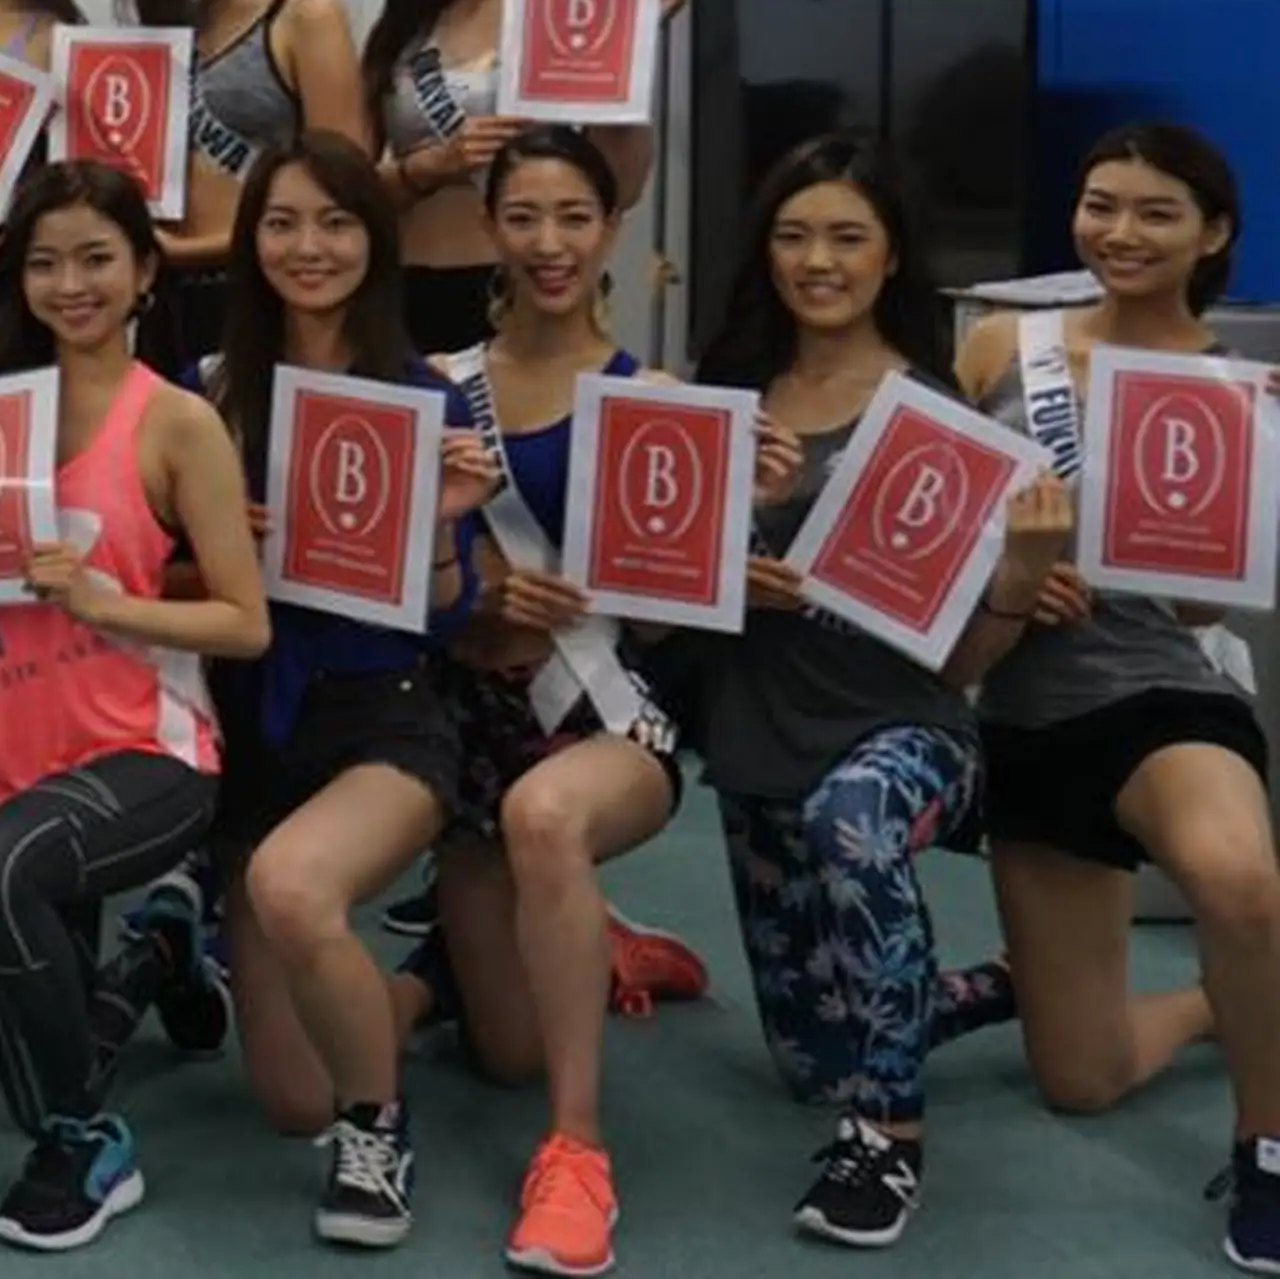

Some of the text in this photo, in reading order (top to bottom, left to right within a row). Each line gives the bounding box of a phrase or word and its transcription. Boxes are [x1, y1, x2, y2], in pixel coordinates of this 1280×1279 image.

[104, 75, 131, 126] B
[336, 440, 366, 503] B
[646, 445, 679, 508] B
[1162, 418, 1198, 482] B
[897, 464, 945, 526] B
